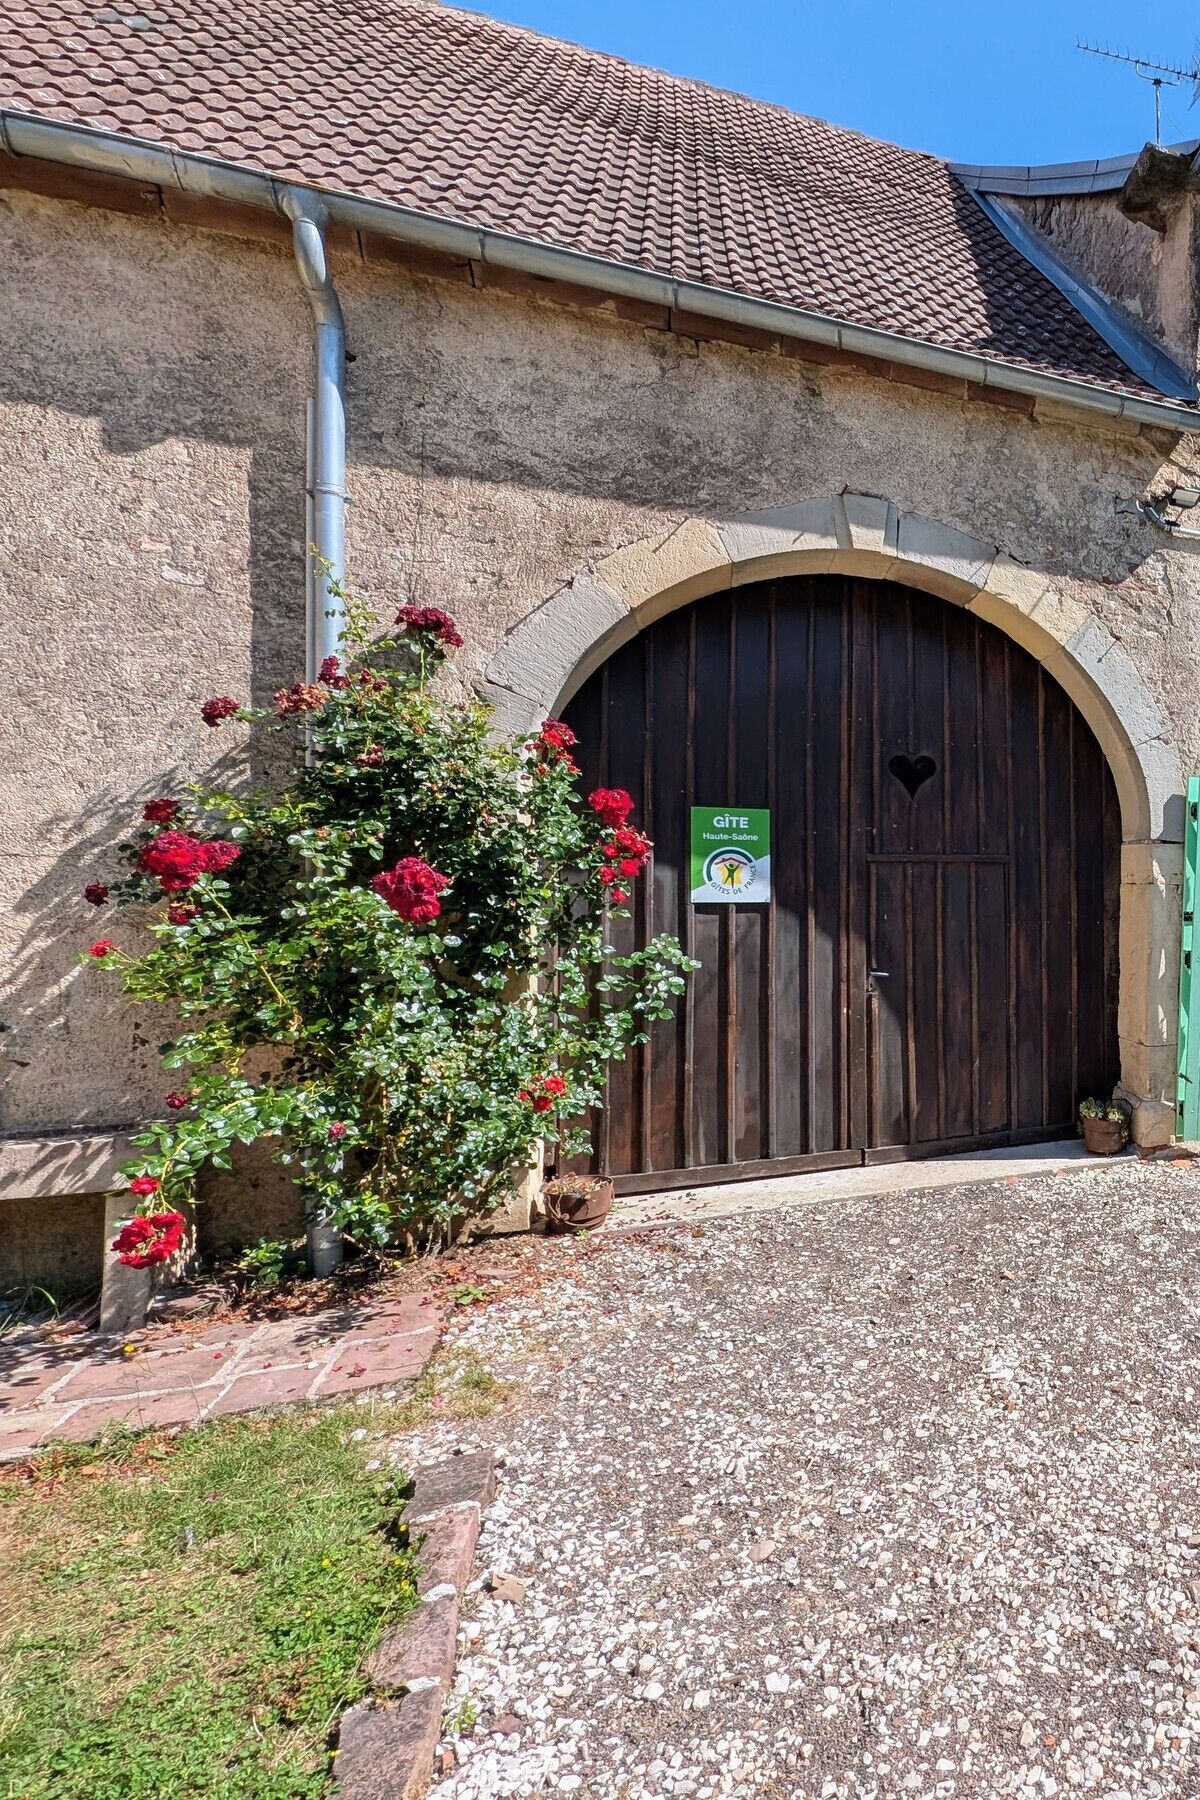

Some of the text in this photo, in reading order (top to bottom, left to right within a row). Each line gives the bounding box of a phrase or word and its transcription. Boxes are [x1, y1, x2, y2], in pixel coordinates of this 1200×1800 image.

[713, 813, 749, 829] GÎTE
[703, 832, 759, 841] Haute-Saône
[744, 864, 757, 890] FRANCE
